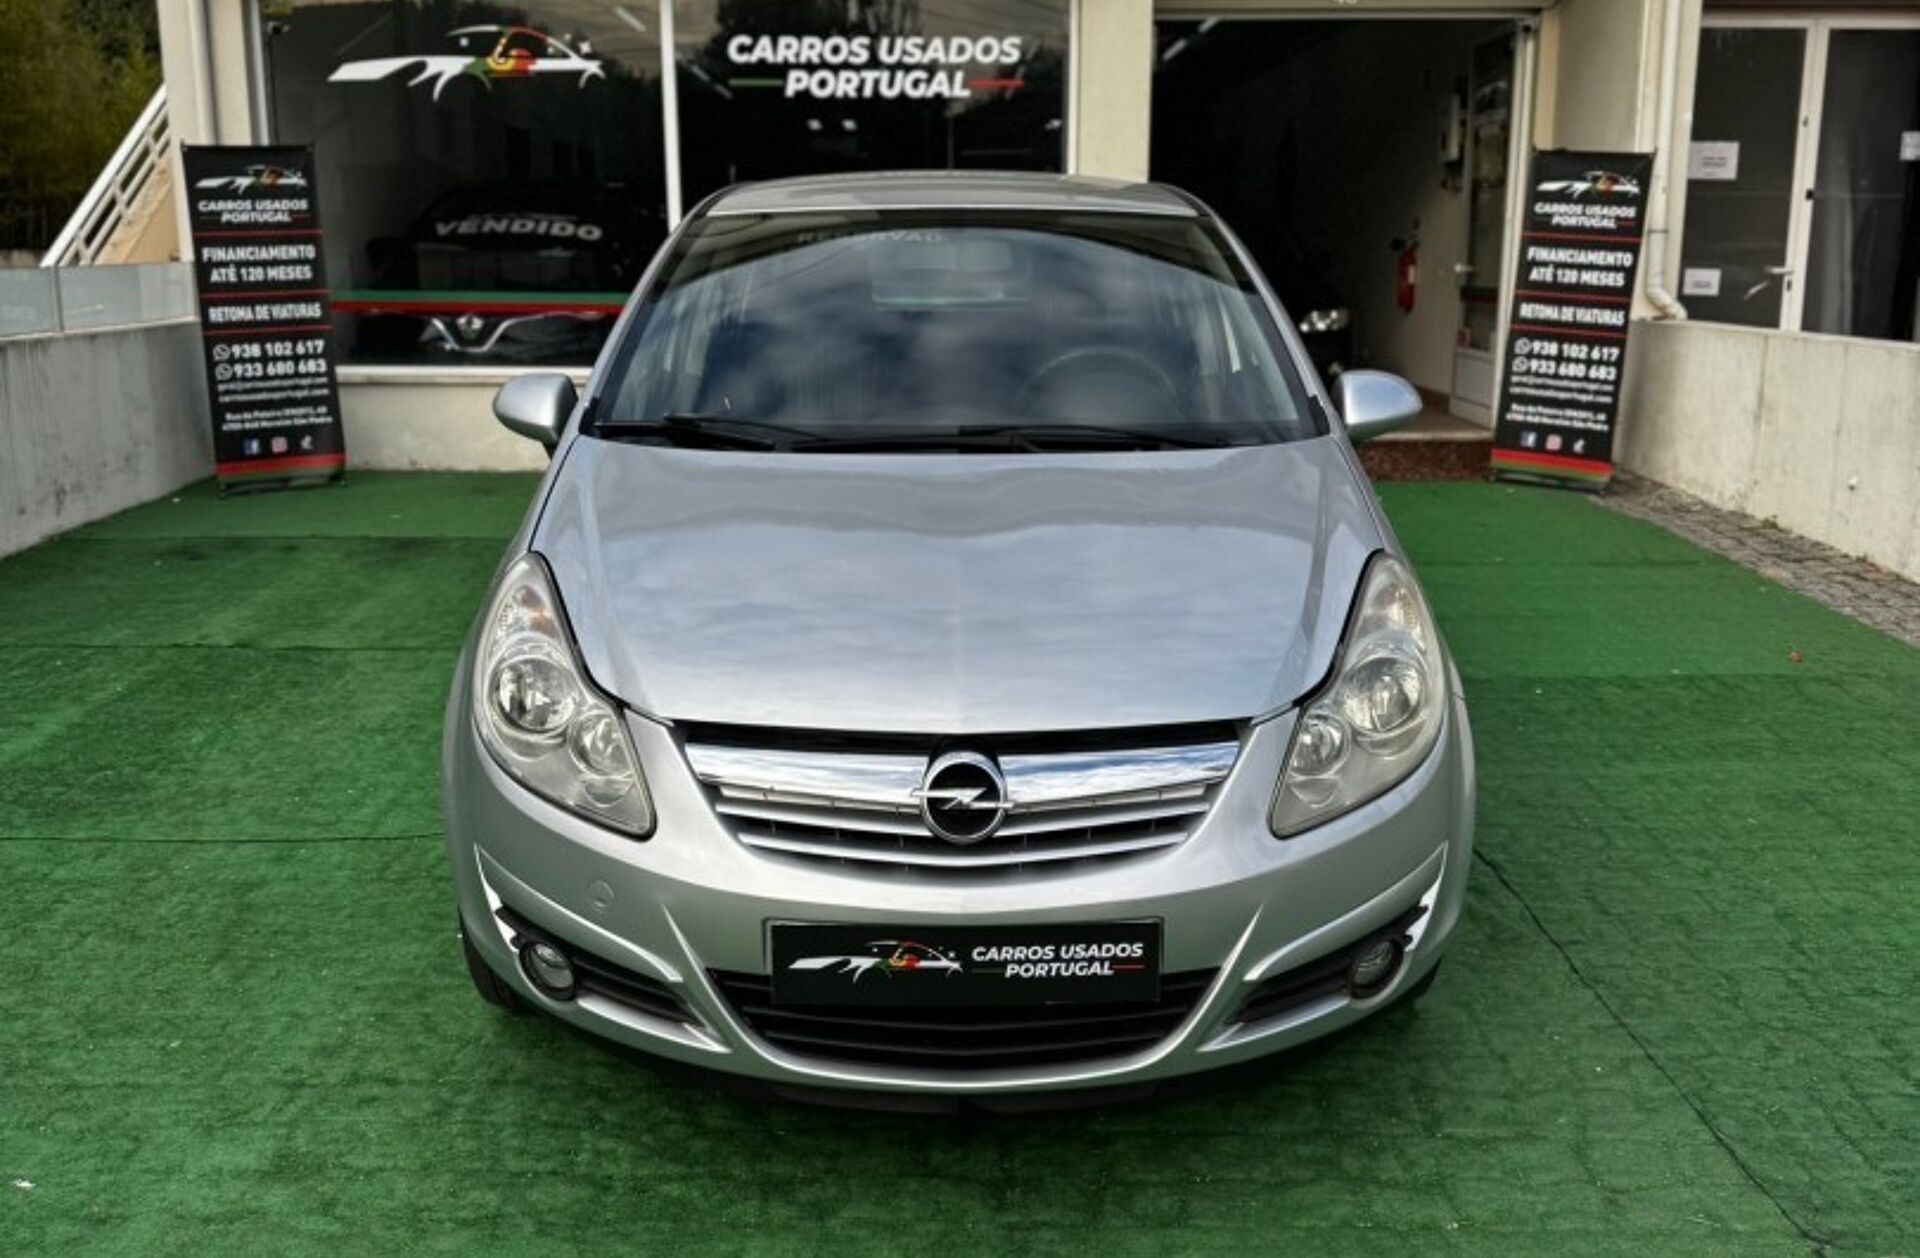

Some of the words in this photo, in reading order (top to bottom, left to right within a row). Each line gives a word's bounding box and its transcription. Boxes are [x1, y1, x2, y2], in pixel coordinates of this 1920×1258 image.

[727, 35, 871, 64] CARROS
[878, 36, 1022, 64] USADOS
[784, 69, 972, 98] PORTUGAL
[198, 200, 252, 212] CARROS
[255, 198, 309, 211] USADOS
[1534, 202, 1583, 214] CARROS
[1585, 204, 1636, 218] USADOS
[221, 211, 292, 223] PORTUGAL
[1552, 216, 1617, 229] PORTUGAL
[435, 218, 603, 241] VENDIDO
[201, 244, 316, 263] FINANCIAMENTO
[1527, 247, 1633, 268] FINANCIAMENTO
[210, 264, 238, 283] ATÉ
[240, 267, 264, 282] 120
[267, 265, 312, 281] MESES
[1529, 264, 1554, 283] ATÉ
[1557, 268, 1579, 284] 120
[1581, 270, 1625, 287] MESES
[208, 306, 254, 323] RETOMA
[256, 304, 270, 321] DE
[271, 302, 322, 320] VIATURAS
[1519, 303, 1559, 320] RETOMA
[1561, 306, 1575, 321] DE
[1576, 308, 1626, 326] VIATURAS
[231, 344, 262, 359] 938
[265, 342, 294, 356] 102
[296, 339, 325, 354] 617
[1532, 340, 1559, 356] 938
[1562, 343, 1588, 359] 102
[1591, 346, 1620, 362] 617
[234, 363, 263, 378] 933
[267, 361, 294, 376] 680
[298, 359, 327, 373] 683
[1530, 359, 1556, 375] 933
[1558, 363, 1586, 378] 680
[1588, 365, 1617, 381] 683
[971, 945, 1055, 962] CARROS
[1060, 943, 1144, 960] USADOS
[1004, 961, 1115, 979] PORTUGAL
